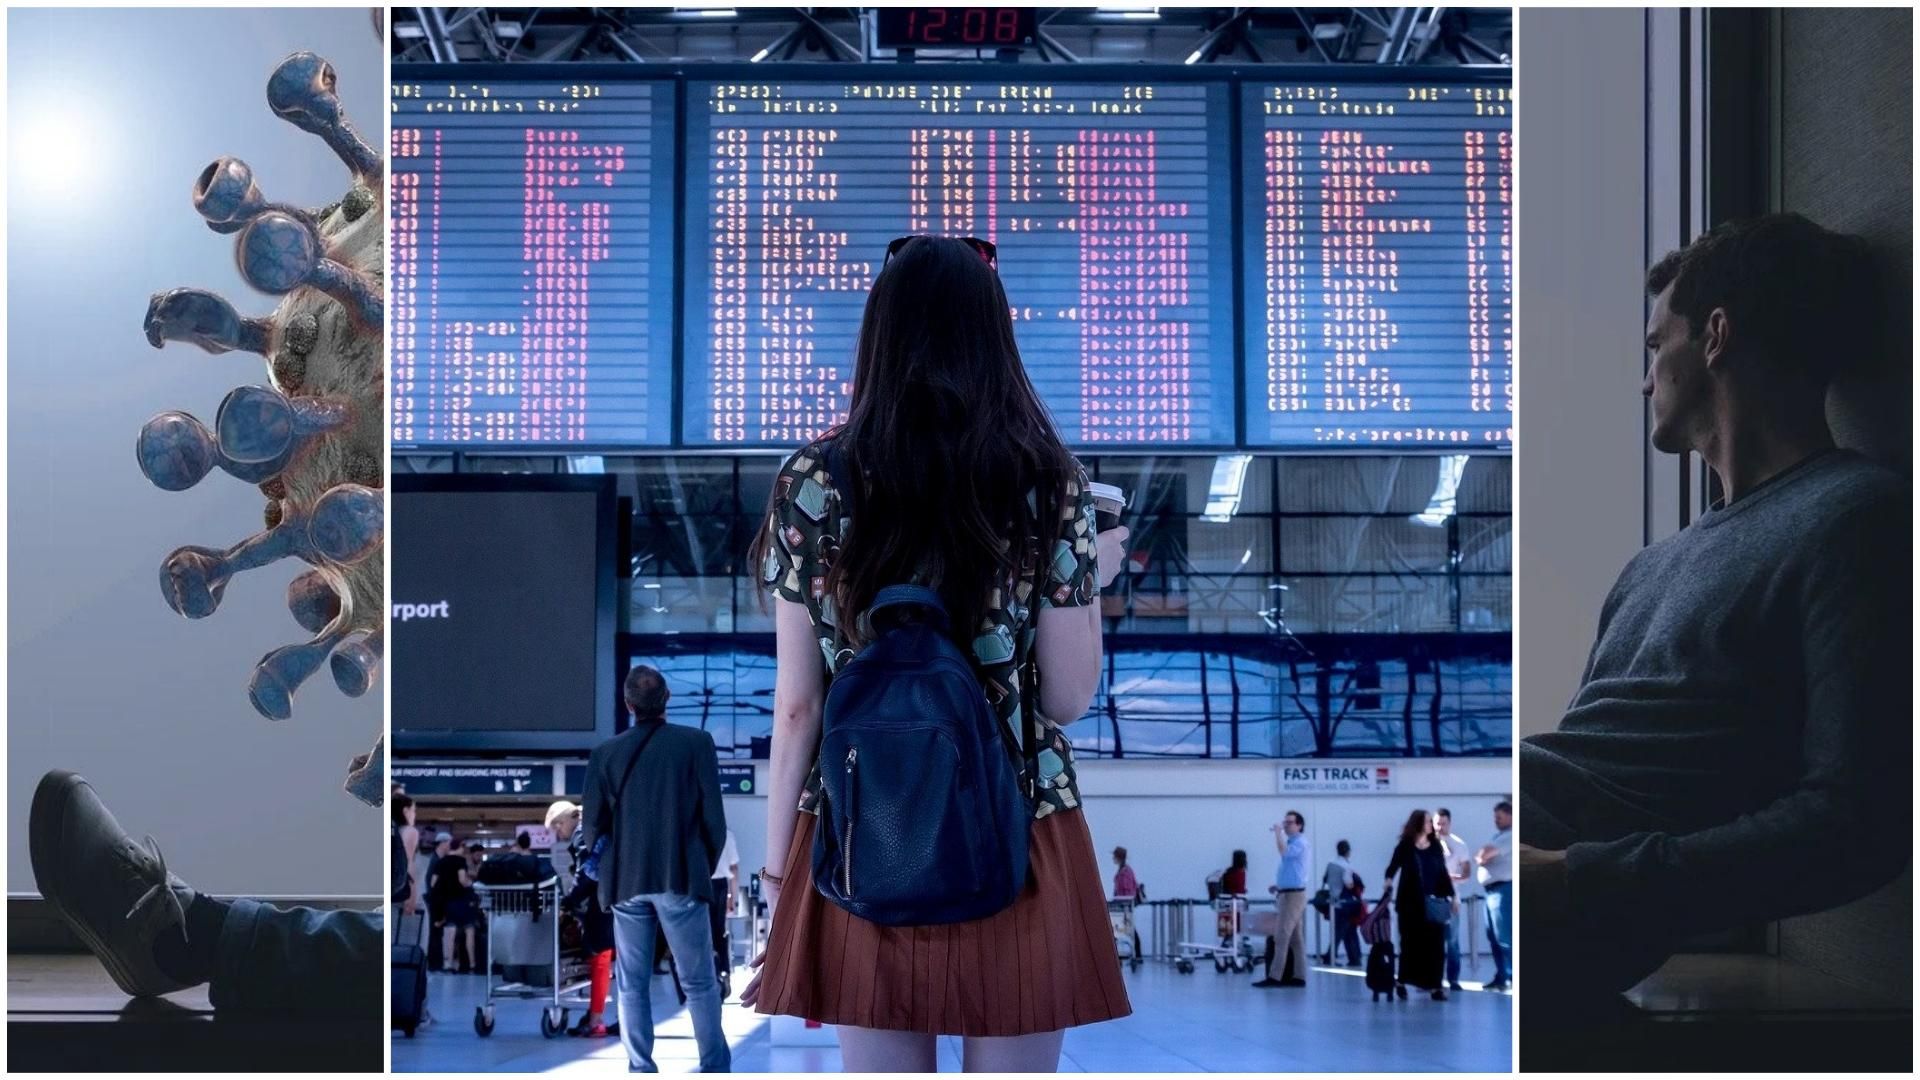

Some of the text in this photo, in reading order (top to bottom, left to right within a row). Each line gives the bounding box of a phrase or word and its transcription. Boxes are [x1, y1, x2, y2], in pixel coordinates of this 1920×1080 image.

[907, 9, 1017, 42] 12:08
[392, 600, 449, 622] rport
[403, 768, 437, 777] PASSPORT
[438, 768, 453, 777] AND
[508, 768, 531, 777] READY
[1284, 767, 1369, 780] FAST TRACK
